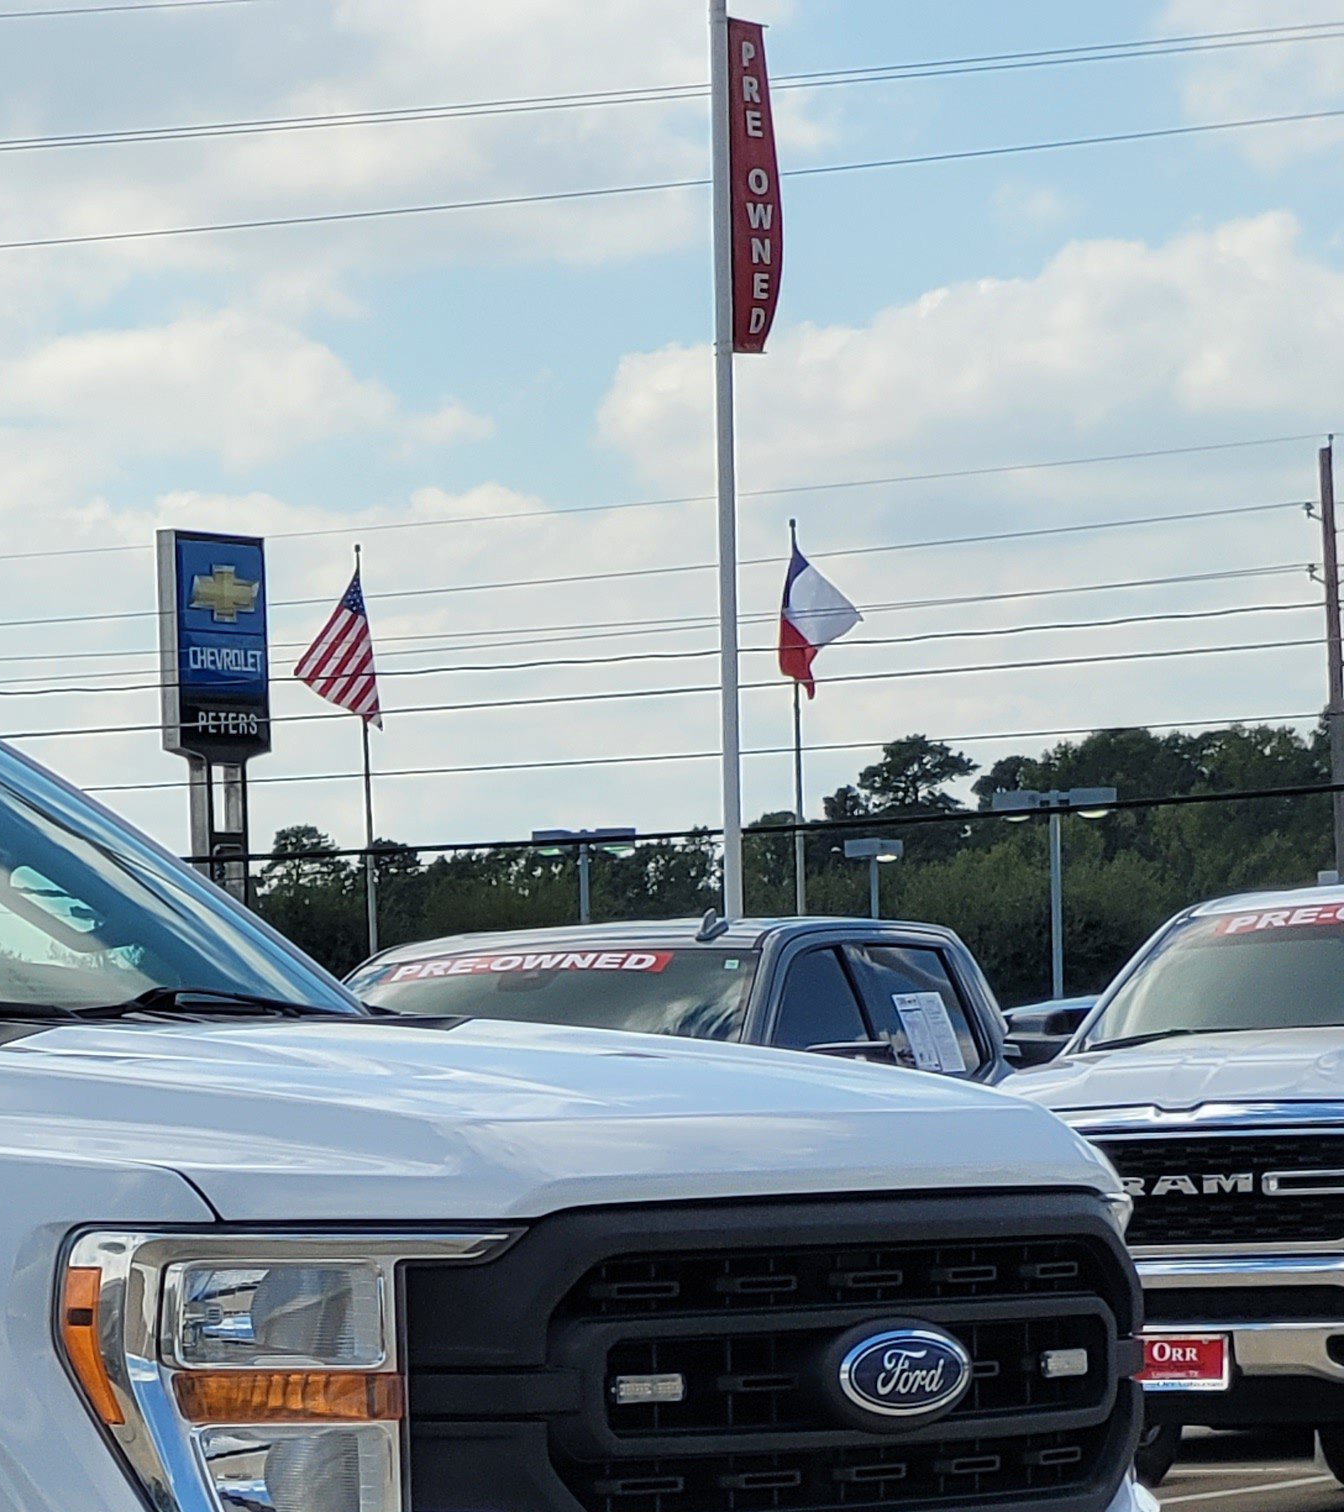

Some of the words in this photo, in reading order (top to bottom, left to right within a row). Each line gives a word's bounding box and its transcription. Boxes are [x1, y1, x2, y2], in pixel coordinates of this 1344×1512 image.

[742, 42, 763, 138] PRE
[746, 168, 774, 334] OWNED
[189, 646, 261, 672] CHEVROLET
[198, 711, 258, 735] PETERS
[390, 953, 658, 982] PRE-OWNED
[1119, 1173, 1253, 1196] RAM
[876, 1348, 945, 1396] Ford
